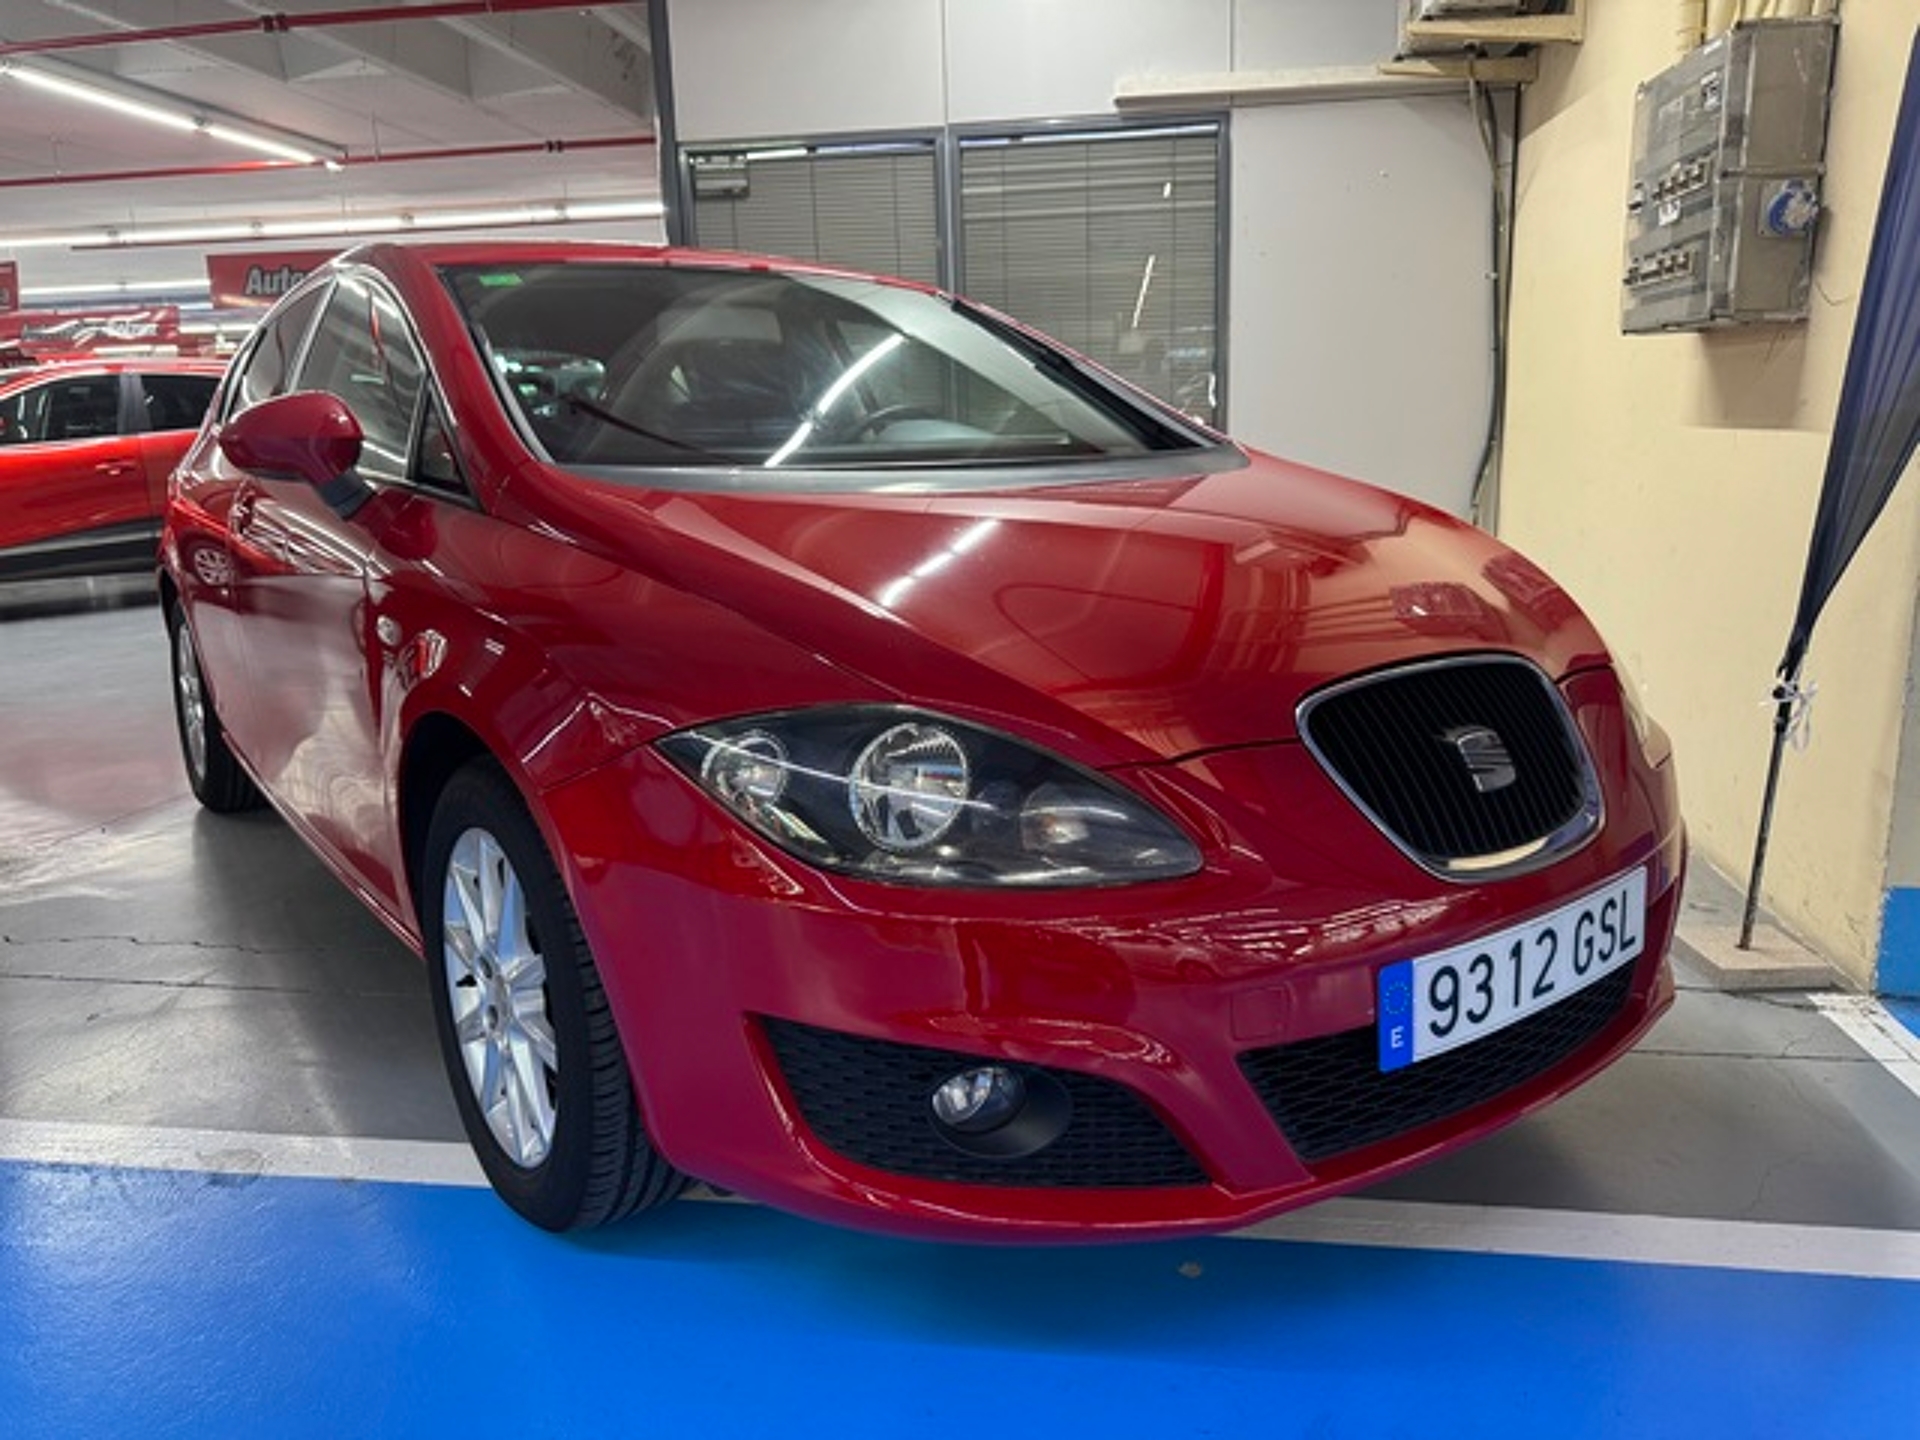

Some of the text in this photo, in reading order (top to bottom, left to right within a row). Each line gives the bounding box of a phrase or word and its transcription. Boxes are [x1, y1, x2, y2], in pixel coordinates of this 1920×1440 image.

[1428, 889, 1637, 1038] 9312 GSL
[1390, 1025, 1405, 1049] E
